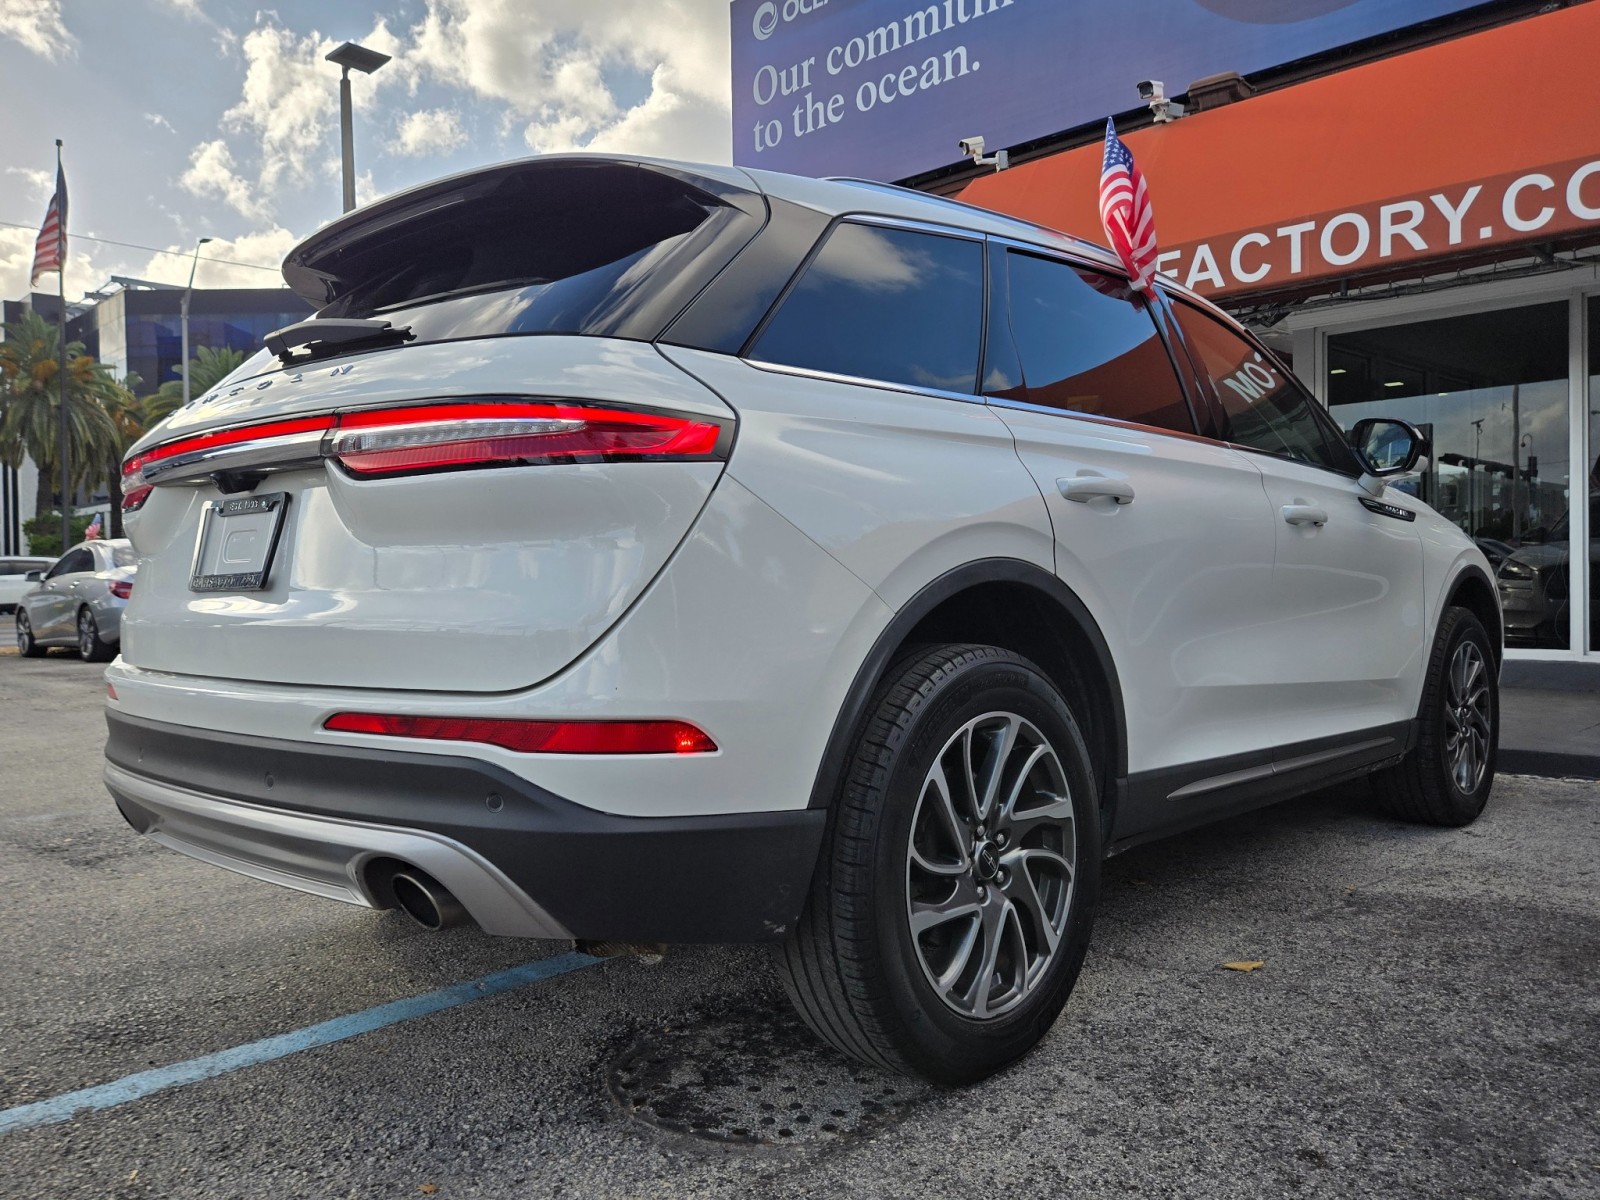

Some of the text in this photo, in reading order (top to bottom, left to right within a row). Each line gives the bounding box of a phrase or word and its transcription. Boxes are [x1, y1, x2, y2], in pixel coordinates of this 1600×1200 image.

[753, 56, 815, 105] Our
[753, 45, 980, 152] to the ocean.
